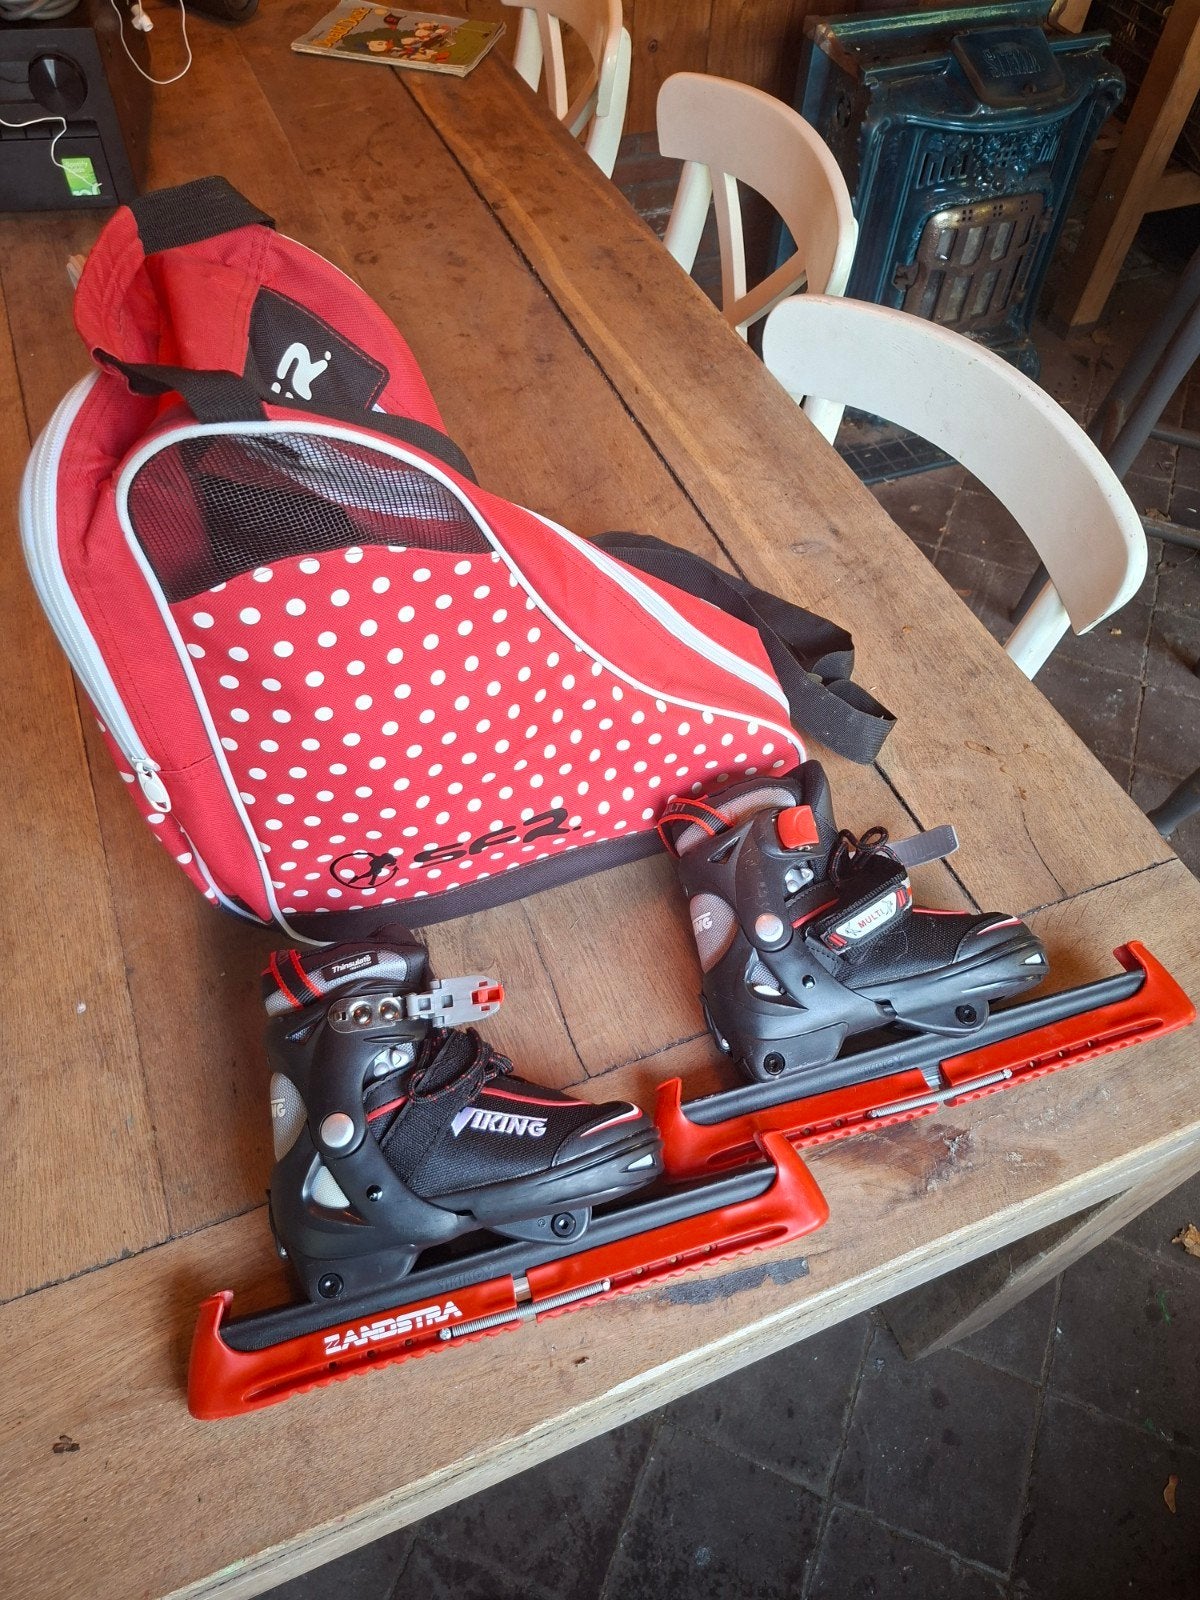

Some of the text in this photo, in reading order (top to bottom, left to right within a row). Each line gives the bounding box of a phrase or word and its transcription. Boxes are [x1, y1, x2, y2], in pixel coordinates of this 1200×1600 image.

[857, 908, 885, 929] MULTI
[451, 1106, 548, 1137] VIKING
[323, 1300, 463, 1355] ZANDSTRA
